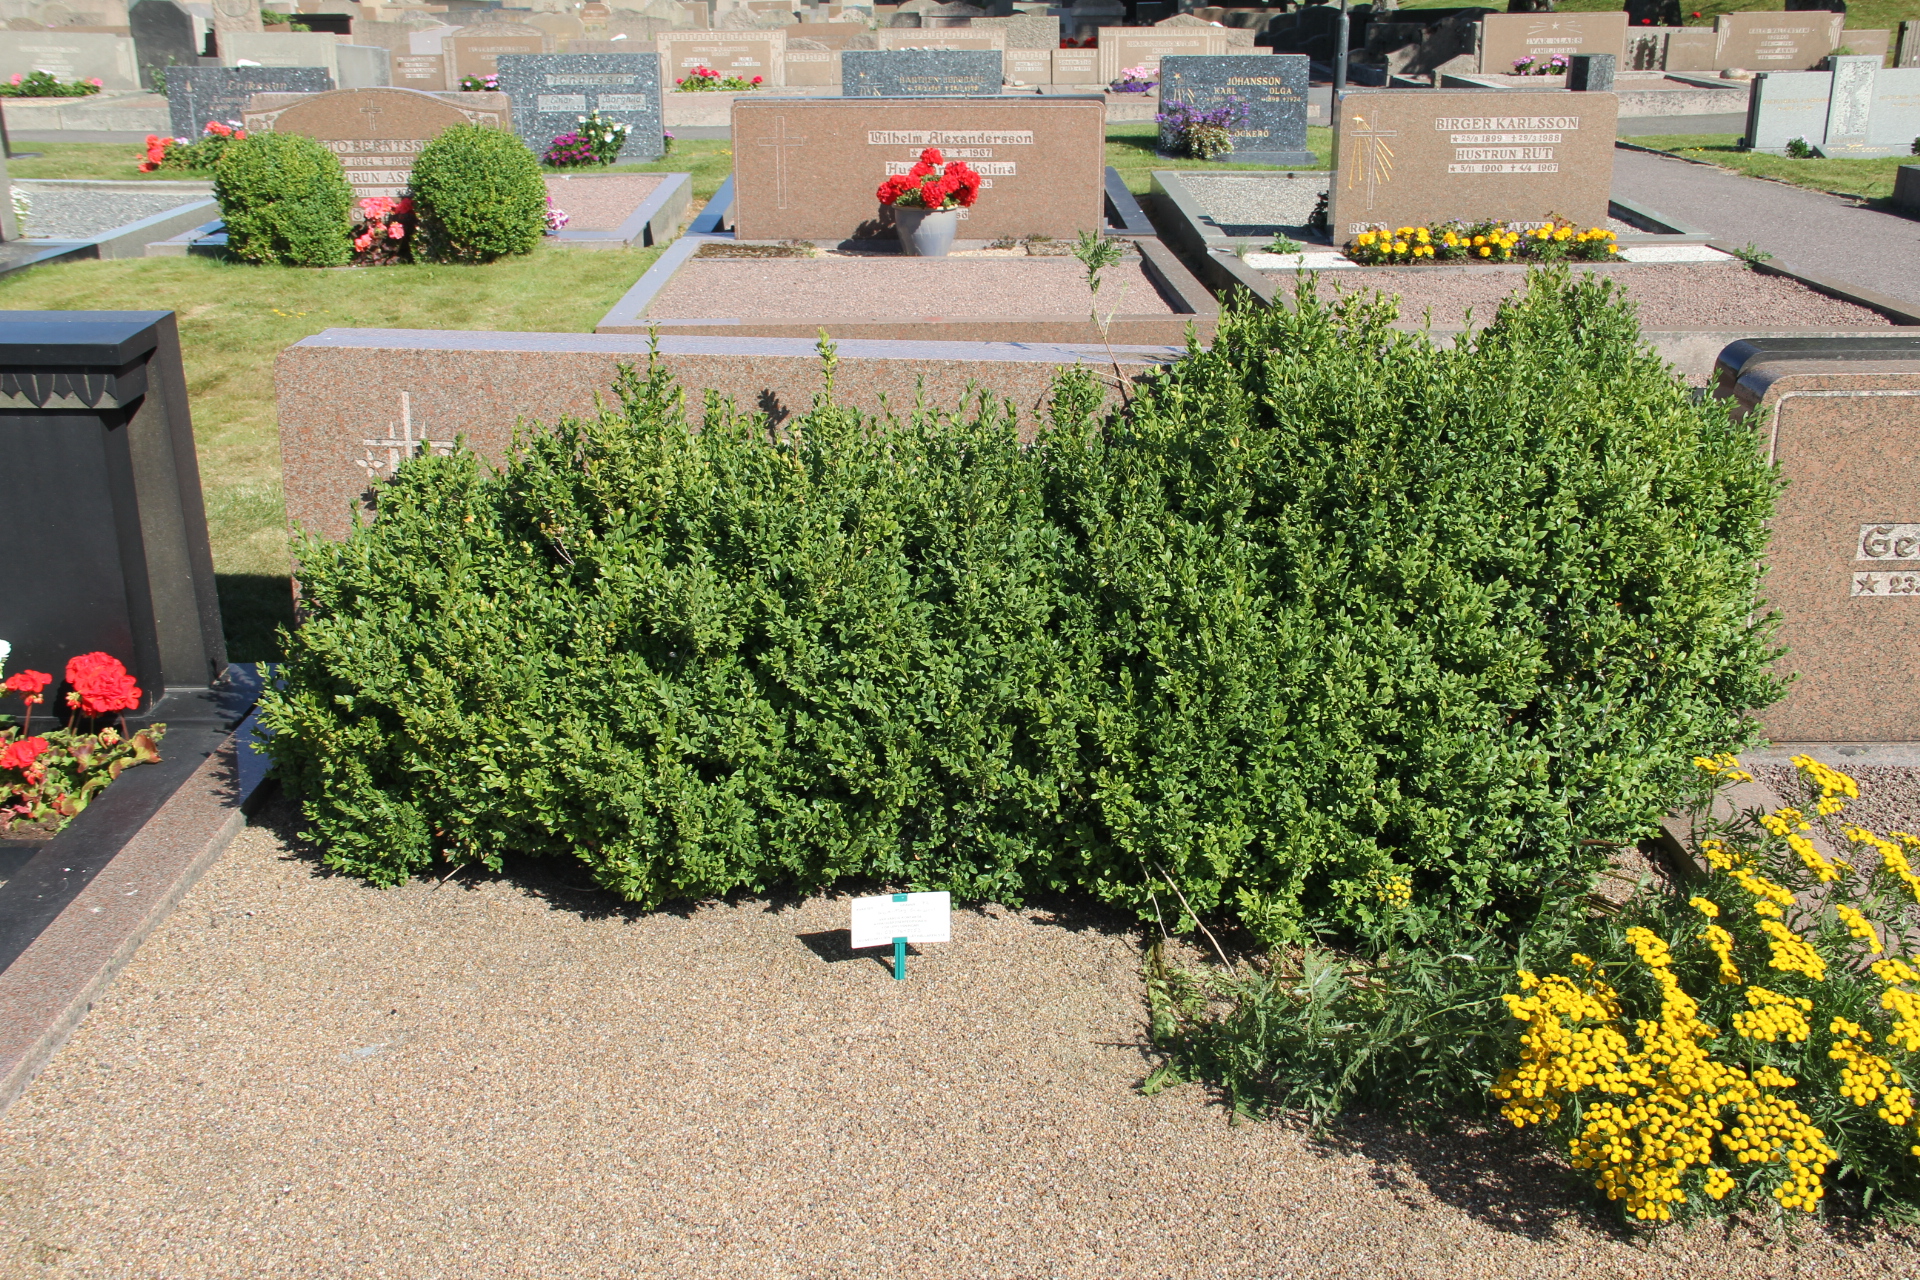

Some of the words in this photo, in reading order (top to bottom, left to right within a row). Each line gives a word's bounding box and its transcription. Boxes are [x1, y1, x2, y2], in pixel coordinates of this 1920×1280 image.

[1227, 76, 1281, 86] JOHANSSON
[1213, 87, 1237, 95] KARL
[1269, 87, 1292, 95] OLGA
[1436, 118, 1492, 130] BIRGER
[1496, 117, 1578, 129] KARLSSON
[869, 131, 923, 144] Wilhelm
[927, 131, 1033, 144] Alexandersson
[1539, 134, 1560, 142] 1988
[969, 148, 992, 157] 1967
[1456, 149, 1517, 159] HUSTRUN
[1522, 147, 1553, 159] RUT
[352, 157, 374, 166] 1904
[968, 162, 1015, 175] ikolina
[1481, 164, 1503, 172] 1900
[1537, 163, 1558, 172] 1967
